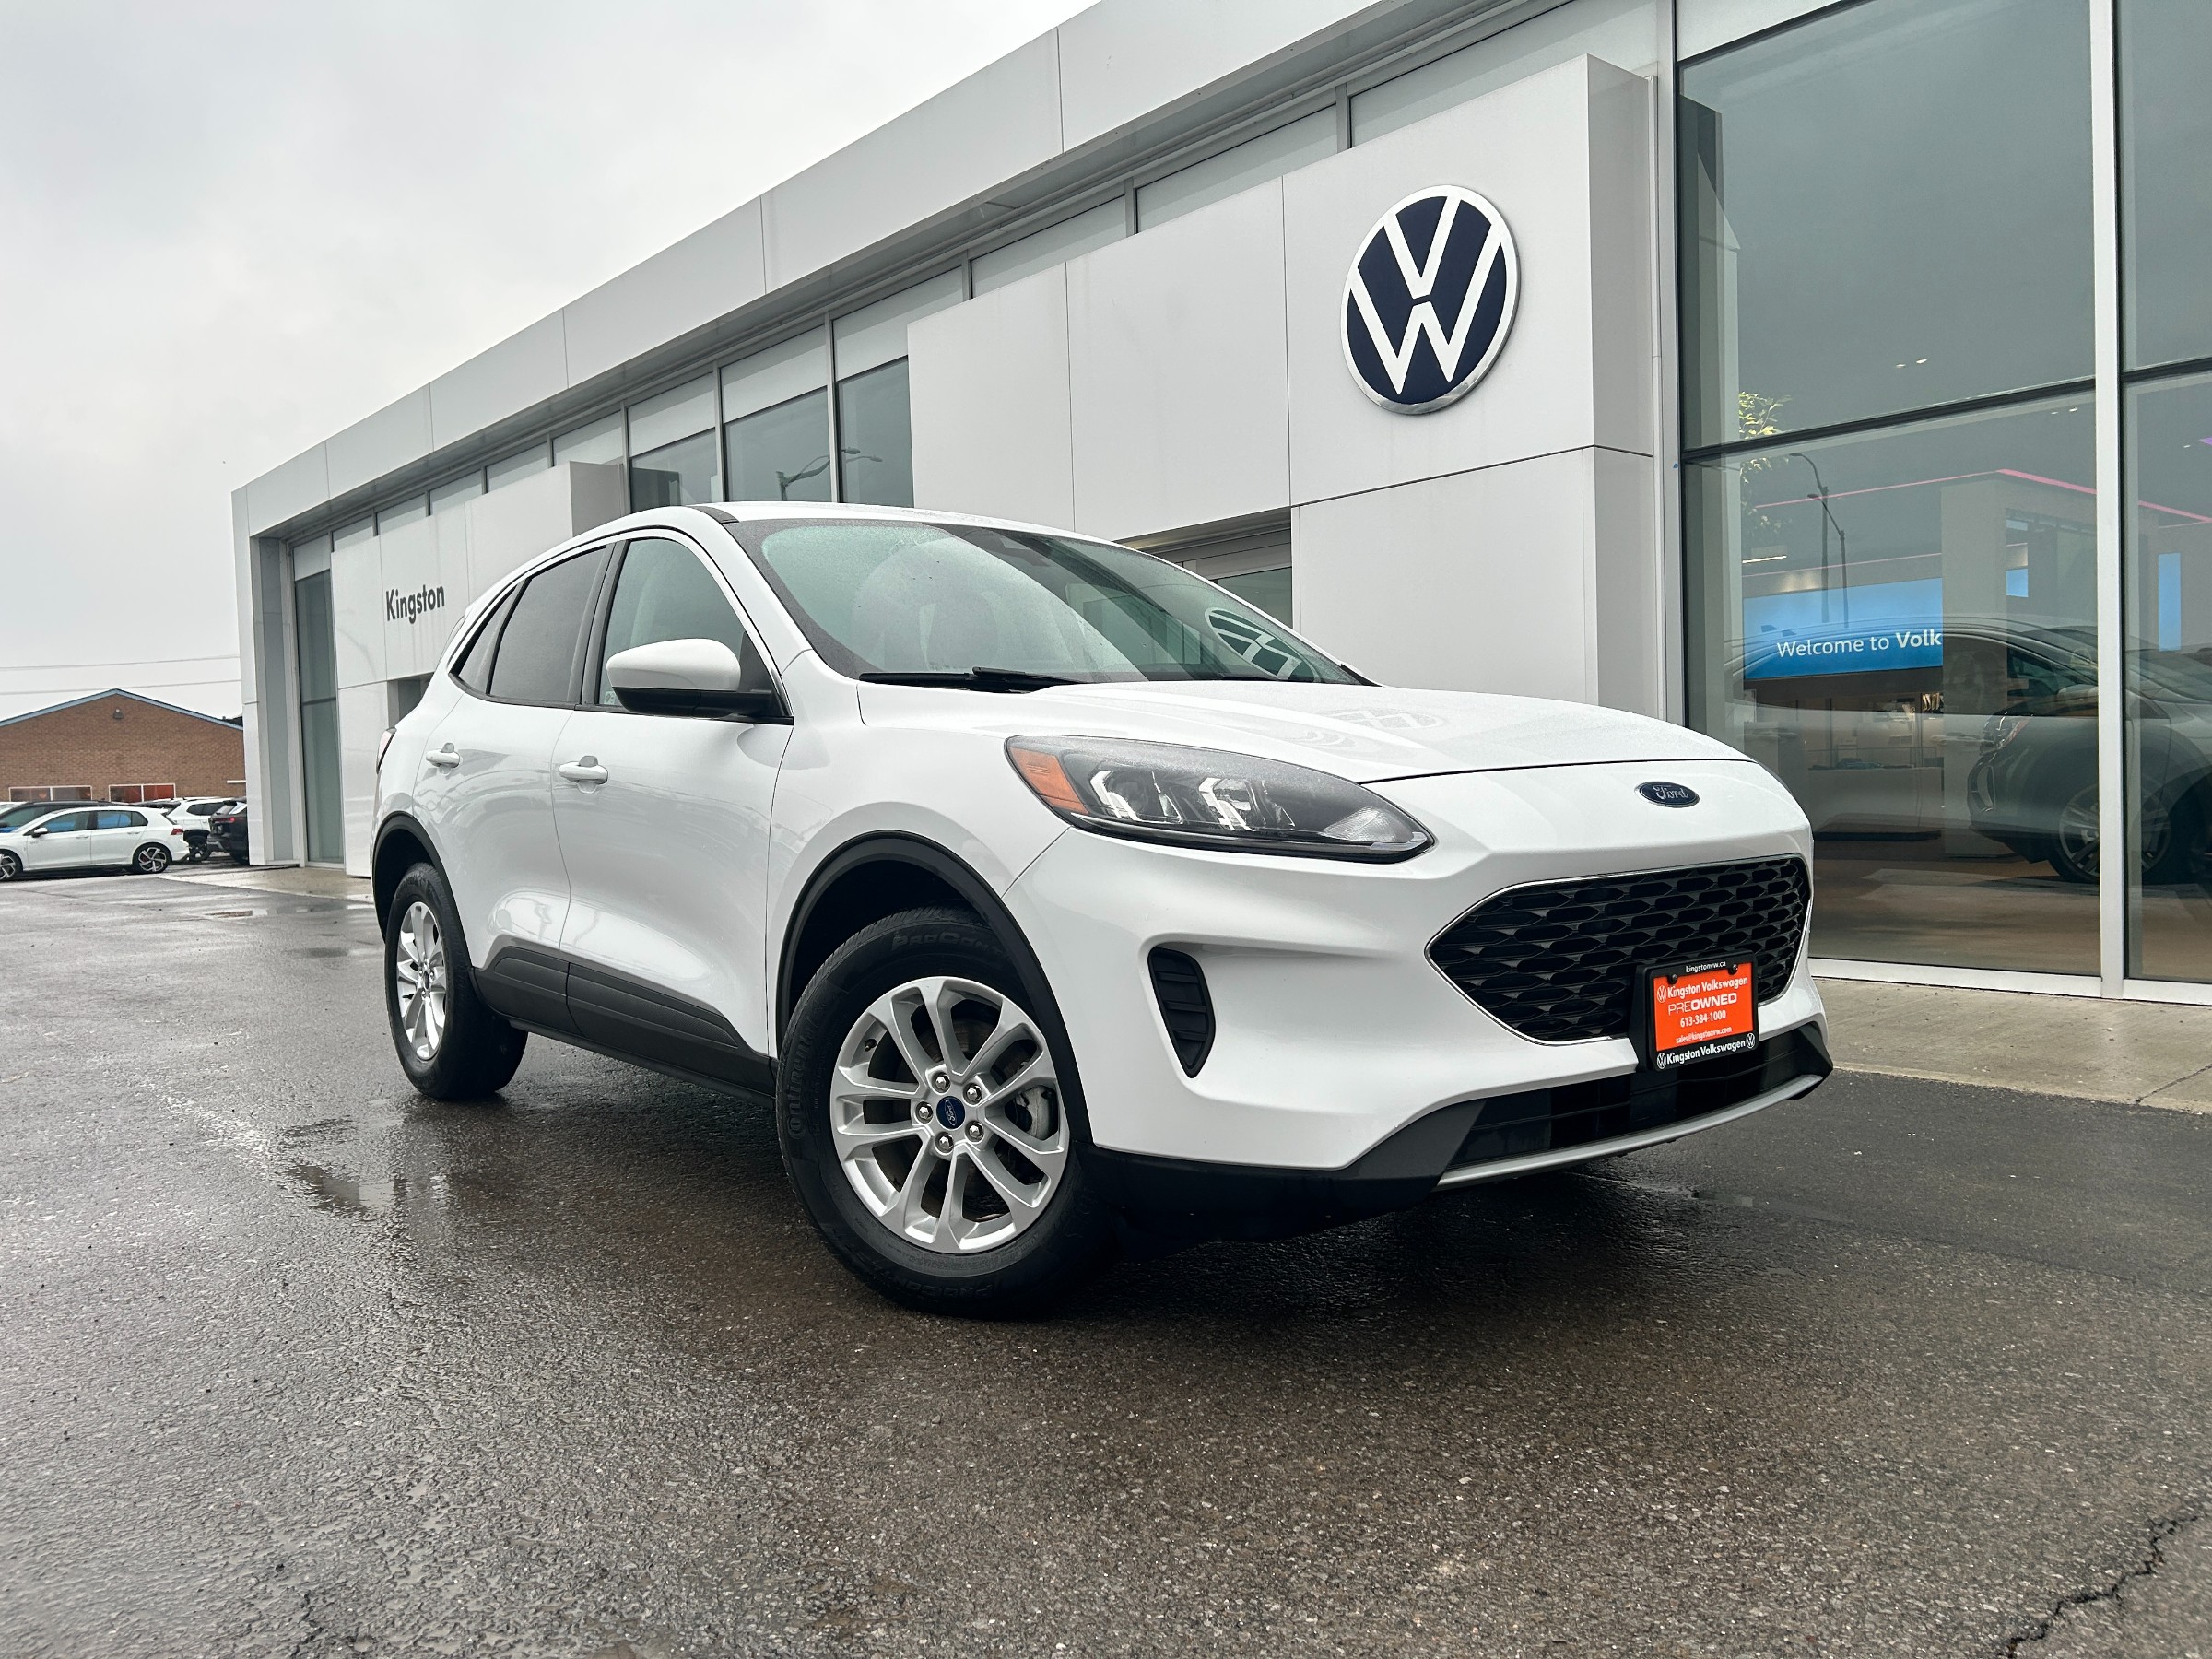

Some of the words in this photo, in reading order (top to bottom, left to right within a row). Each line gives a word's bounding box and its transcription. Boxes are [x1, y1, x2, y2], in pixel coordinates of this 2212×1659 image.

[1341, 184, 1521, 415] VW
[385, 583, 445, 624] Kingston
[1777, 638, 1864, 657] Welcome
[1870, 636, 1889, 651] to
[1896, 629, 1942, 648] Volk
[1652, 784, 1688, 800] Ford
[1686, 961, 1726, 973] kingstonvw.ca
[1667, 985, 1700, 999] Kingston
[1701, 977, 1748, 992] Volkswagen
[1668, 993, 1737, 1015] PREOWNED
[1680, 1010, 1726, 1028] 613-384-1000
[1666, 1053, 1700, 1065] Kingston
[1700, 1040, 1746, 1056] Volkswagen
